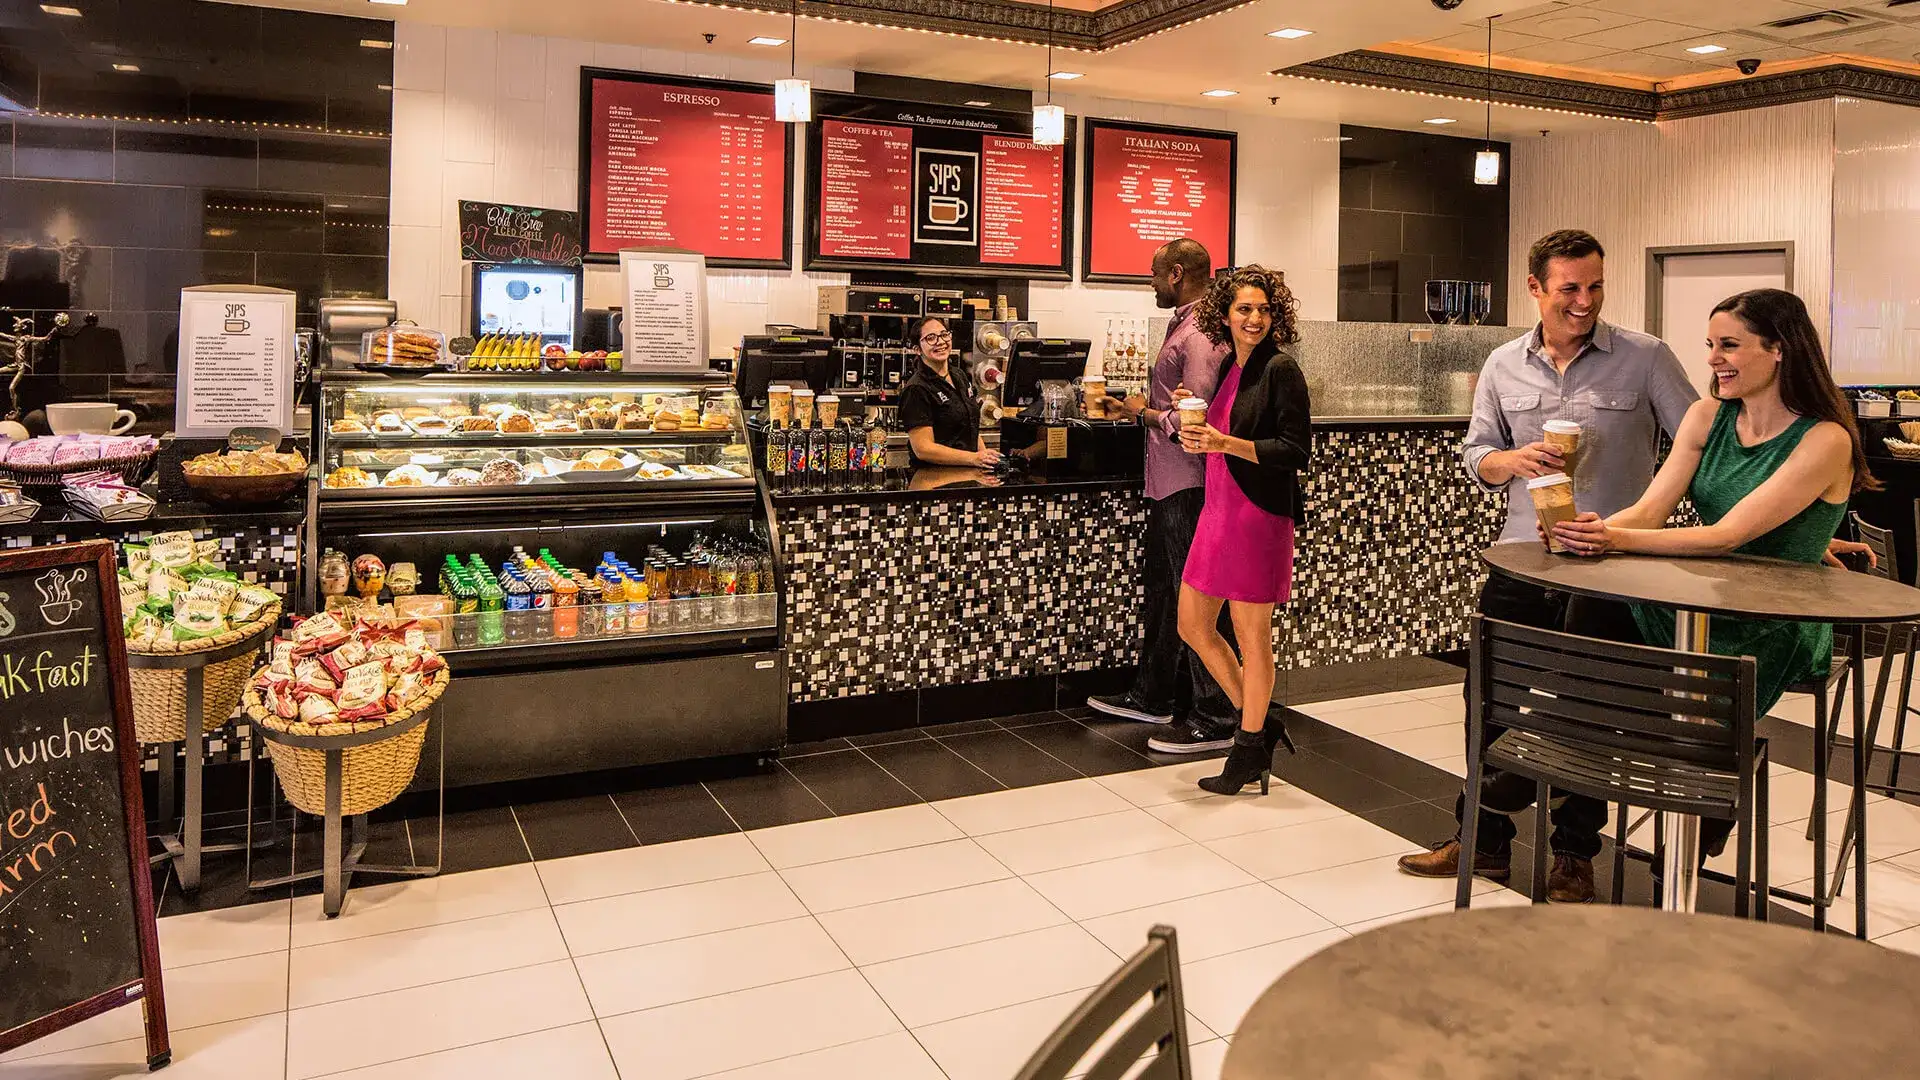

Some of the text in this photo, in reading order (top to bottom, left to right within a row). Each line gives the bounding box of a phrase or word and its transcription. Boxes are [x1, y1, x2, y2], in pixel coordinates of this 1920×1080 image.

[663, 92, 720, 106] ESPRESSO
[897, 112, 915, 122] Coffee,
[843, 126, 871, 135] COFFEE
[879, 129, 893, 137] TEA
[993, 139, 1053, 151] BLENDED DRINKS
[1125, 136, 1201, 152] ITALIAN SODA
[928, 163, 961, 195] SIPS
[493, 226, 517, 236] ICED
[653, 263, 670, 276] SIPS
[224, 303, 246, 319] SIPS
